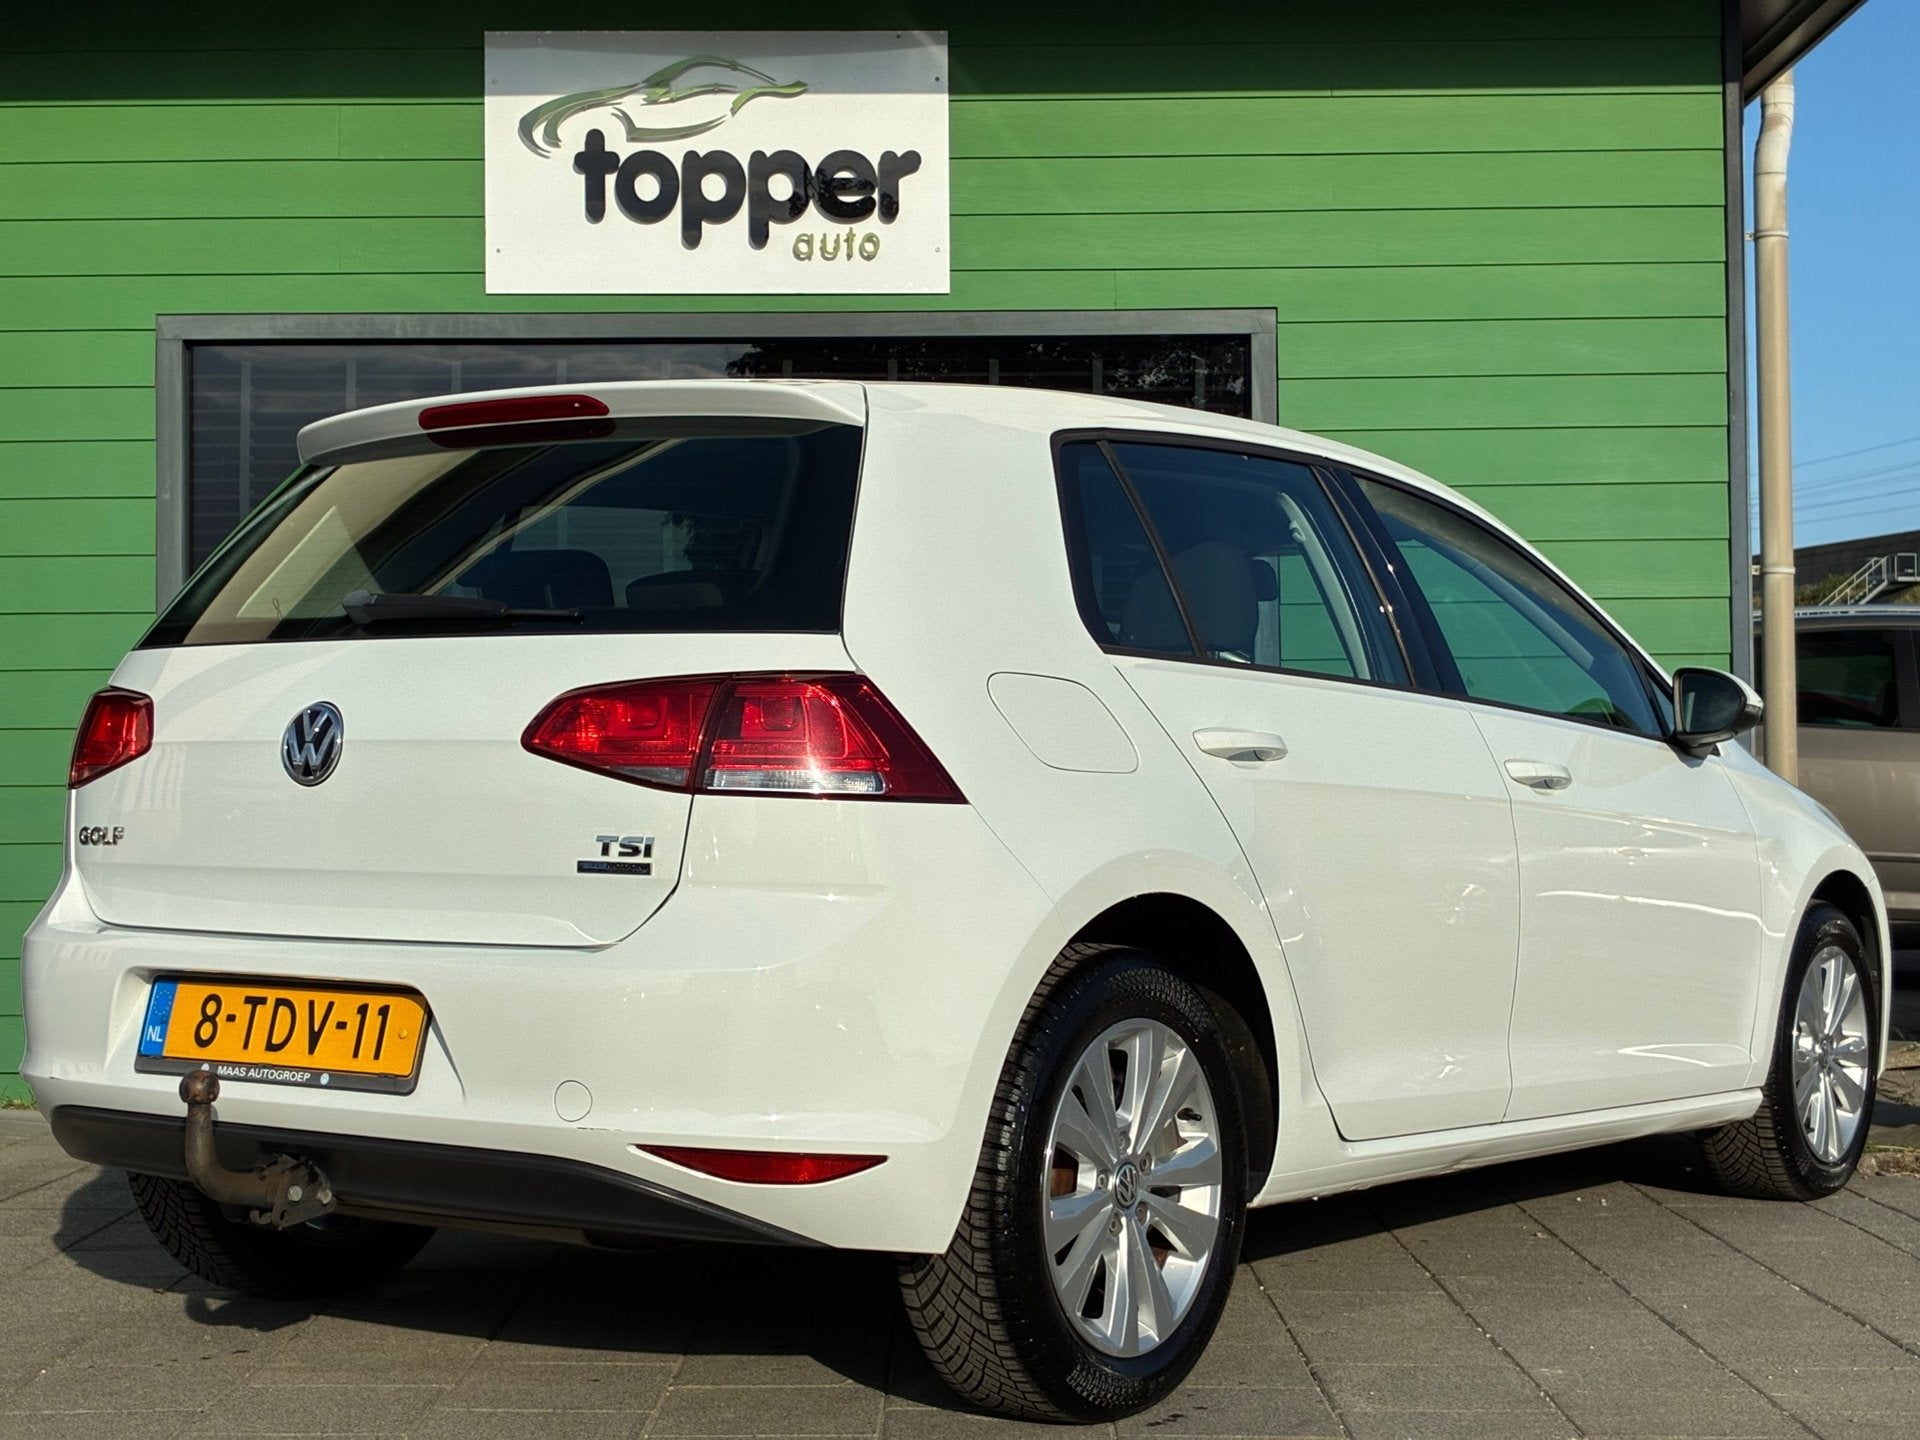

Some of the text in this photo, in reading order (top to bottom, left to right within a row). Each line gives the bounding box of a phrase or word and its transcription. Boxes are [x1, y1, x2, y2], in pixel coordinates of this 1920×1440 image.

[573, 128, 922, 250] topper
[792, 226, 881, 262] auto
[79, 826, 125, 846] GOLF
[595, 835, 655, 858] TSI
[146, 1024, 163, 1042] NL
[193, 993, 391, 1061] 8-TDV-11
[216, 1065, 311, 1082] MAAS AUTOGROEP
